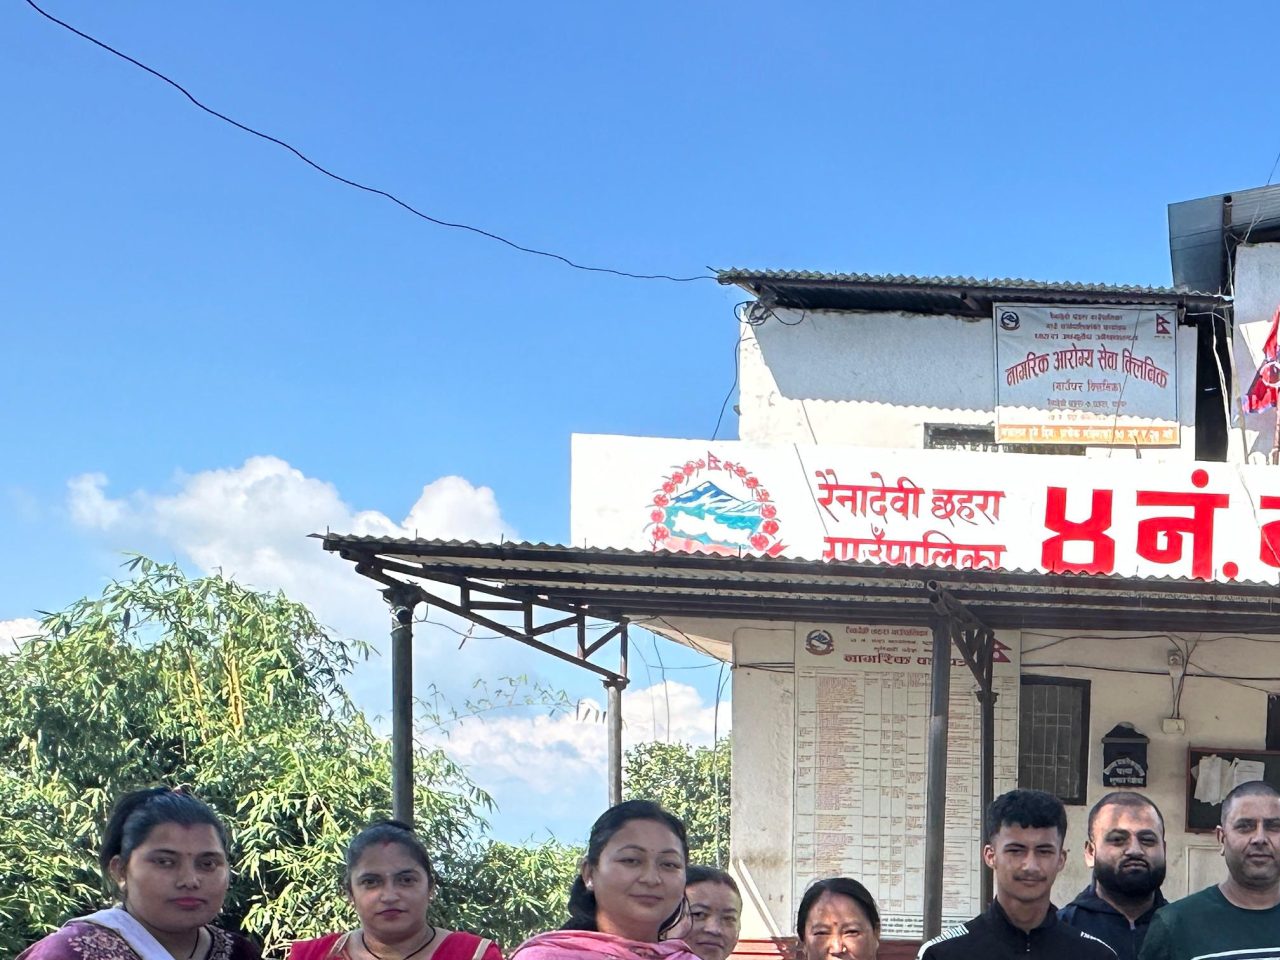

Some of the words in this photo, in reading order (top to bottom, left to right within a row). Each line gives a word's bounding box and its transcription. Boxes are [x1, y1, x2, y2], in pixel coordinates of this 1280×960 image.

[1005, 352, 1049, 387] नागरिक
[1053, 343, 1094, 371] आरोग्य
[1097, 343, 1119, 371] सेवा
[1122, 348, 1169, 389] क्लिनिक
[815, 468, 925, 524] रैनादेवी
[931, 488, 1007, 527] छहरा
[1042, 486, 1115, 575] ४
[1136, 469, 1239, 580] नं.
